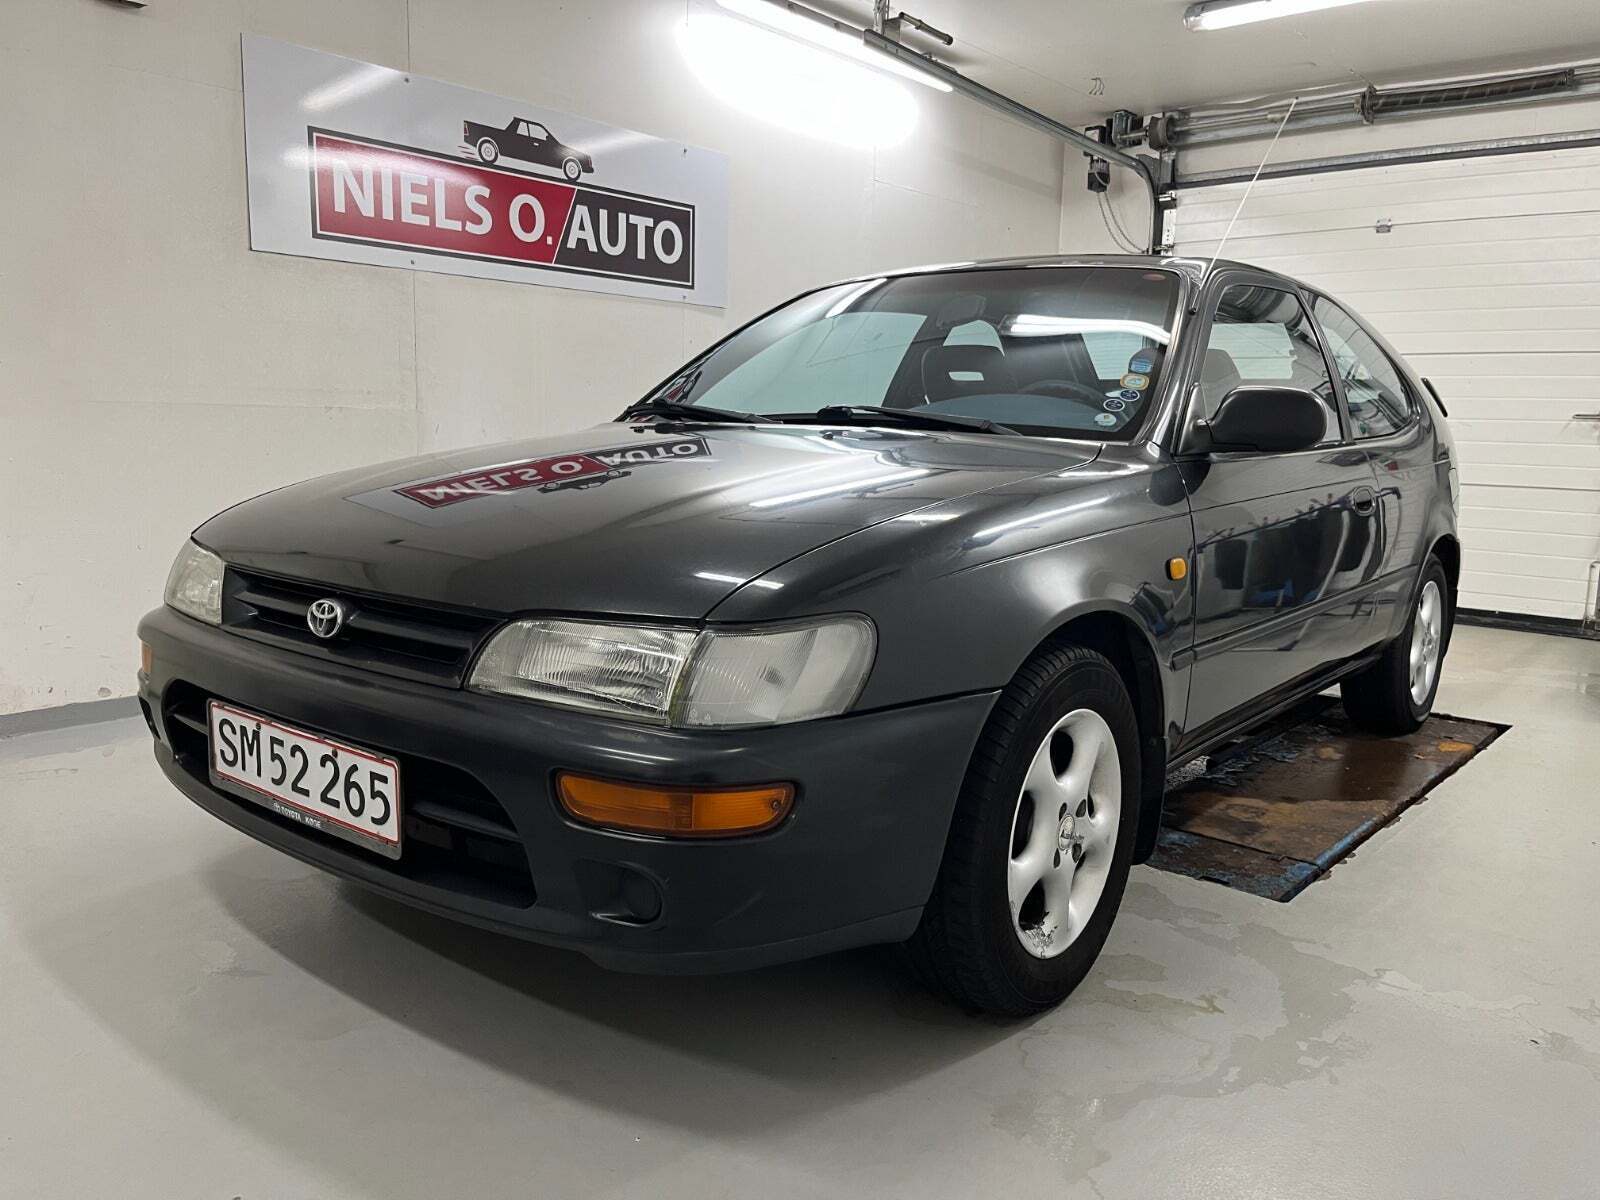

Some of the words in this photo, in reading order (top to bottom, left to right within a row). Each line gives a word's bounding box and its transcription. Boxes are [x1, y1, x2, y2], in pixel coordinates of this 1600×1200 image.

[332, 162, 491, 234] NIELS
[508, 194, 553, 244] O.
[566, 205, 683, 264] AUTO
[219, 719, 261, 777] SM
[269, 736, 310, 797] 52
[320, 753, 390, 825] 265
